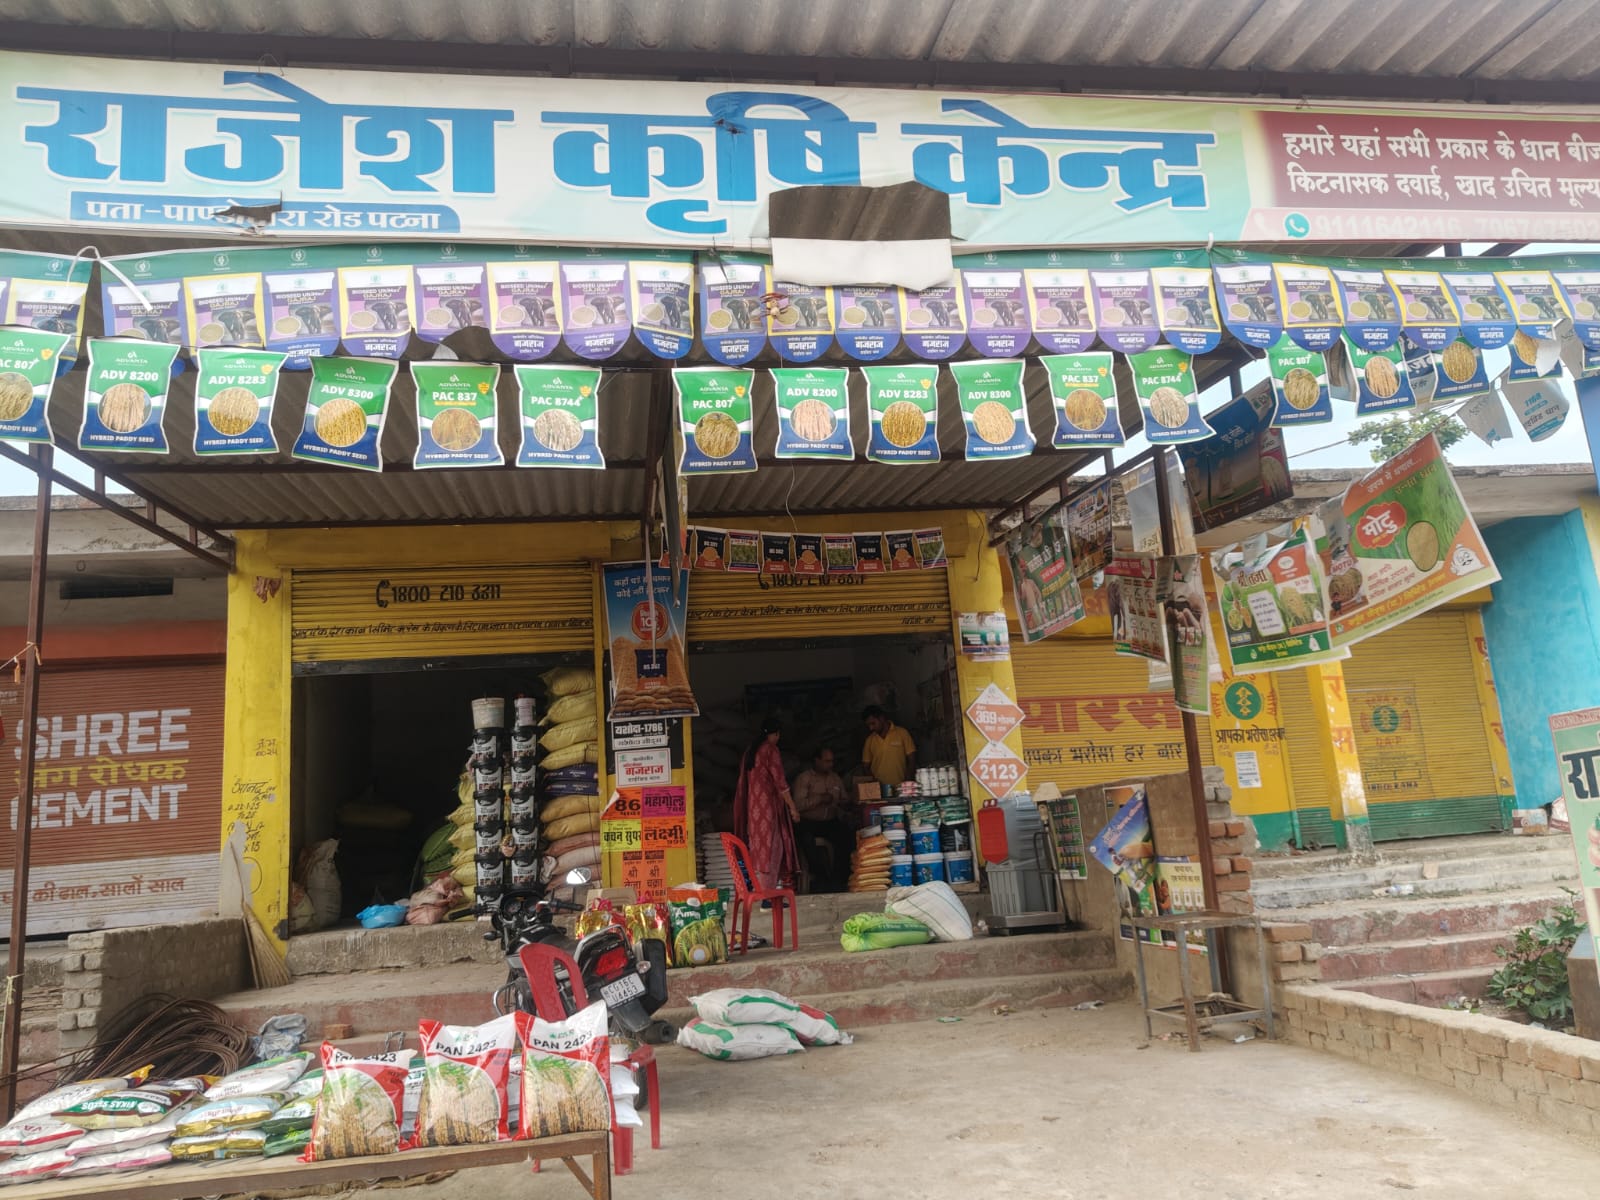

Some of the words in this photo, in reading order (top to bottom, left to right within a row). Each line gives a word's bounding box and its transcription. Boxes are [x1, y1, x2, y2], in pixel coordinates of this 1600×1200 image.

[1283, 124, 1334, 158] हमारे
[1340, 127, 1381, 160] यहां
[1387, 128, 1430, 158] सभी
[1437, 139, 1488, 160] प्रकार
[1494, 131, 1516, 160] के
[1520, 139, 1560, 161] धान
[16, 71, 514, 193] राजेश
[541, 91, 877, 234] कृषि
[901, 99, 1214, 212] केन्द्र
[1287, 161, 1388, 194] किटनासक
[1455, 175, 1496, 199] खाद
[1501, 167, 1552, 198] उचित
[313, 204, 362, 228] रोड
[367, 212, 441, 229] पटना
[1278, 357, 1295, 366] PAC
[100, 370, 126, 381] ADV
[129, 370, 159, 382] 8200
[208, 374, 234, 385] ADV
[237, 374, 266, 386] 8283
[1062, 374, 1081, 383] PAC
[1082, 375, 1099, 384] 837
[1142, 376, 1160, 385] PAC
[321, 384, 346, 396] ADV
[347, 388, 373, 400] 8300
[432, 391, 455, 402] PAC
[456, 391, 477, 402] 837
[787, 387, 810, 398] ADV
[812, 387, 838, 398] 8200
[878, 388, 901, 399] ADV
[903, 388, 929, 399] 8283
[968, 390, 987, 400] ADV
[989, 389, 1011, 400] 8300
[531, 395, 552, 406] PAC
[693, 399, 713, 409] PAC
[1361, 510, 1398, 538] मोटु
[391, 585, 431, 603] 1800
[440, 584, 465, 602] 210
[14, 709, 191, 760] SHREE
[1070, 740, 1115, 763] भरोसा
[1123, 744, 1145, 762] हर
[88, 757, 190, 787] रोधक
[980, 764, 1018, 780] 2123
[11, 784, 188, 830] CEMENT
[436, 1042, 463, 1056] PAN
[533, 1038, 560, 1050] PAN
